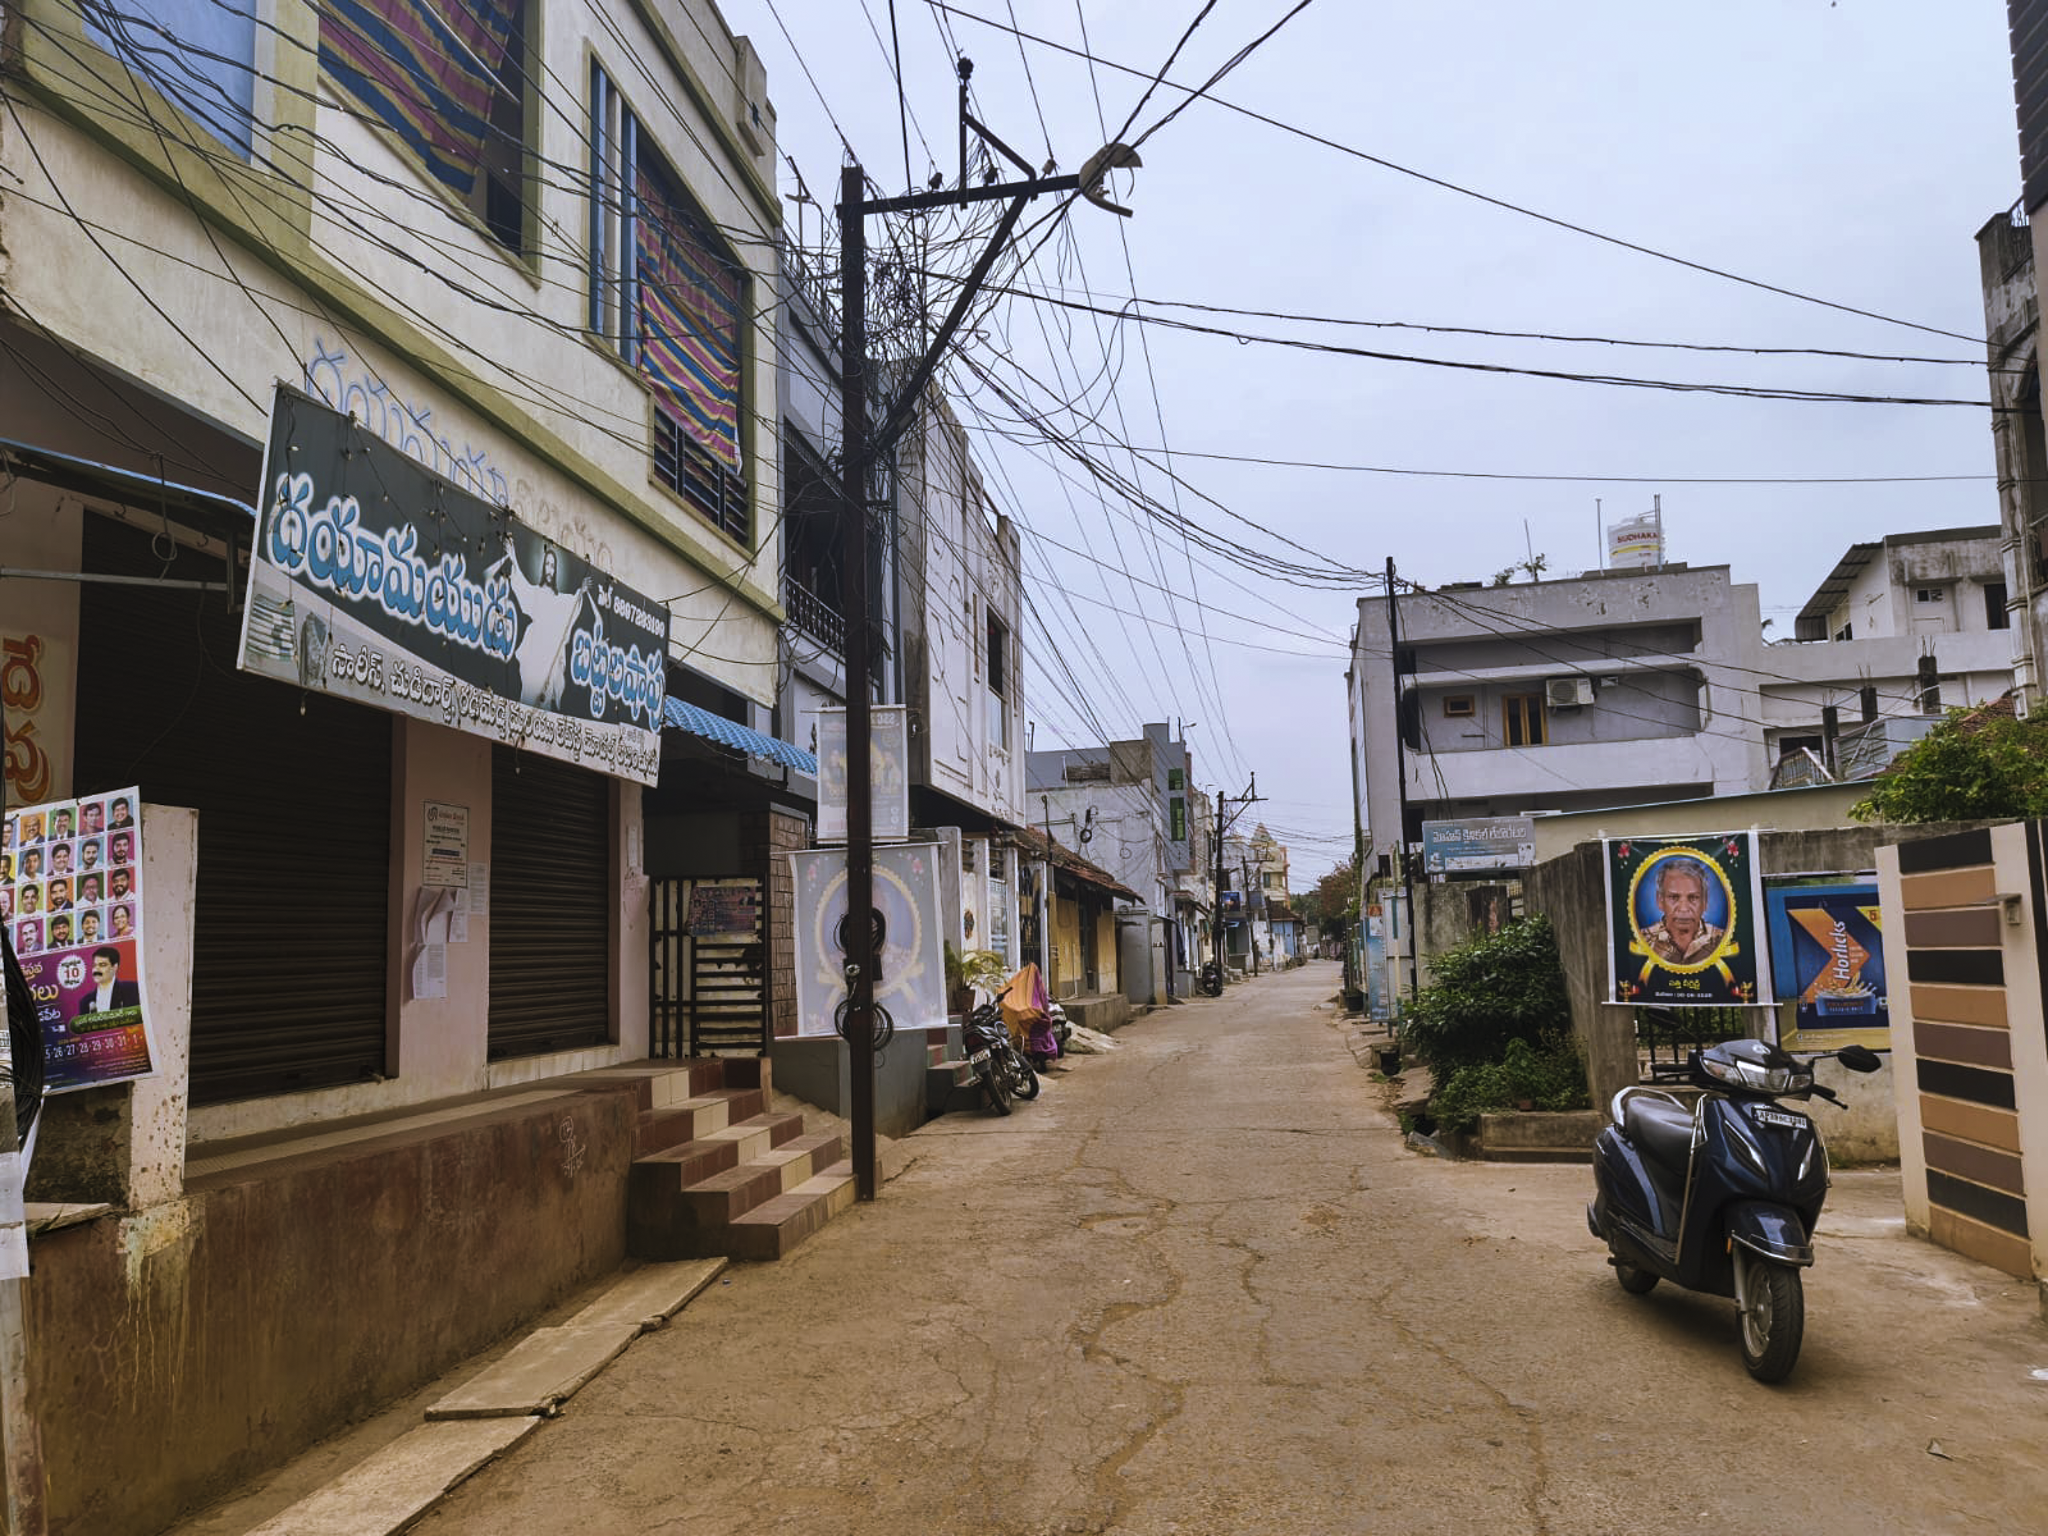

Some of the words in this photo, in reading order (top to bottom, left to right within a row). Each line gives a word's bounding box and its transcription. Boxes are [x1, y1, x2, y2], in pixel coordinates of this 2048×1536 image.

[267, 472, 518, 662] దయామయుడు
[1831, 920, 1851, 981] Horlicks
[64, 967, 80, 979] 10
[66, 1044, 76, 1056] 27
